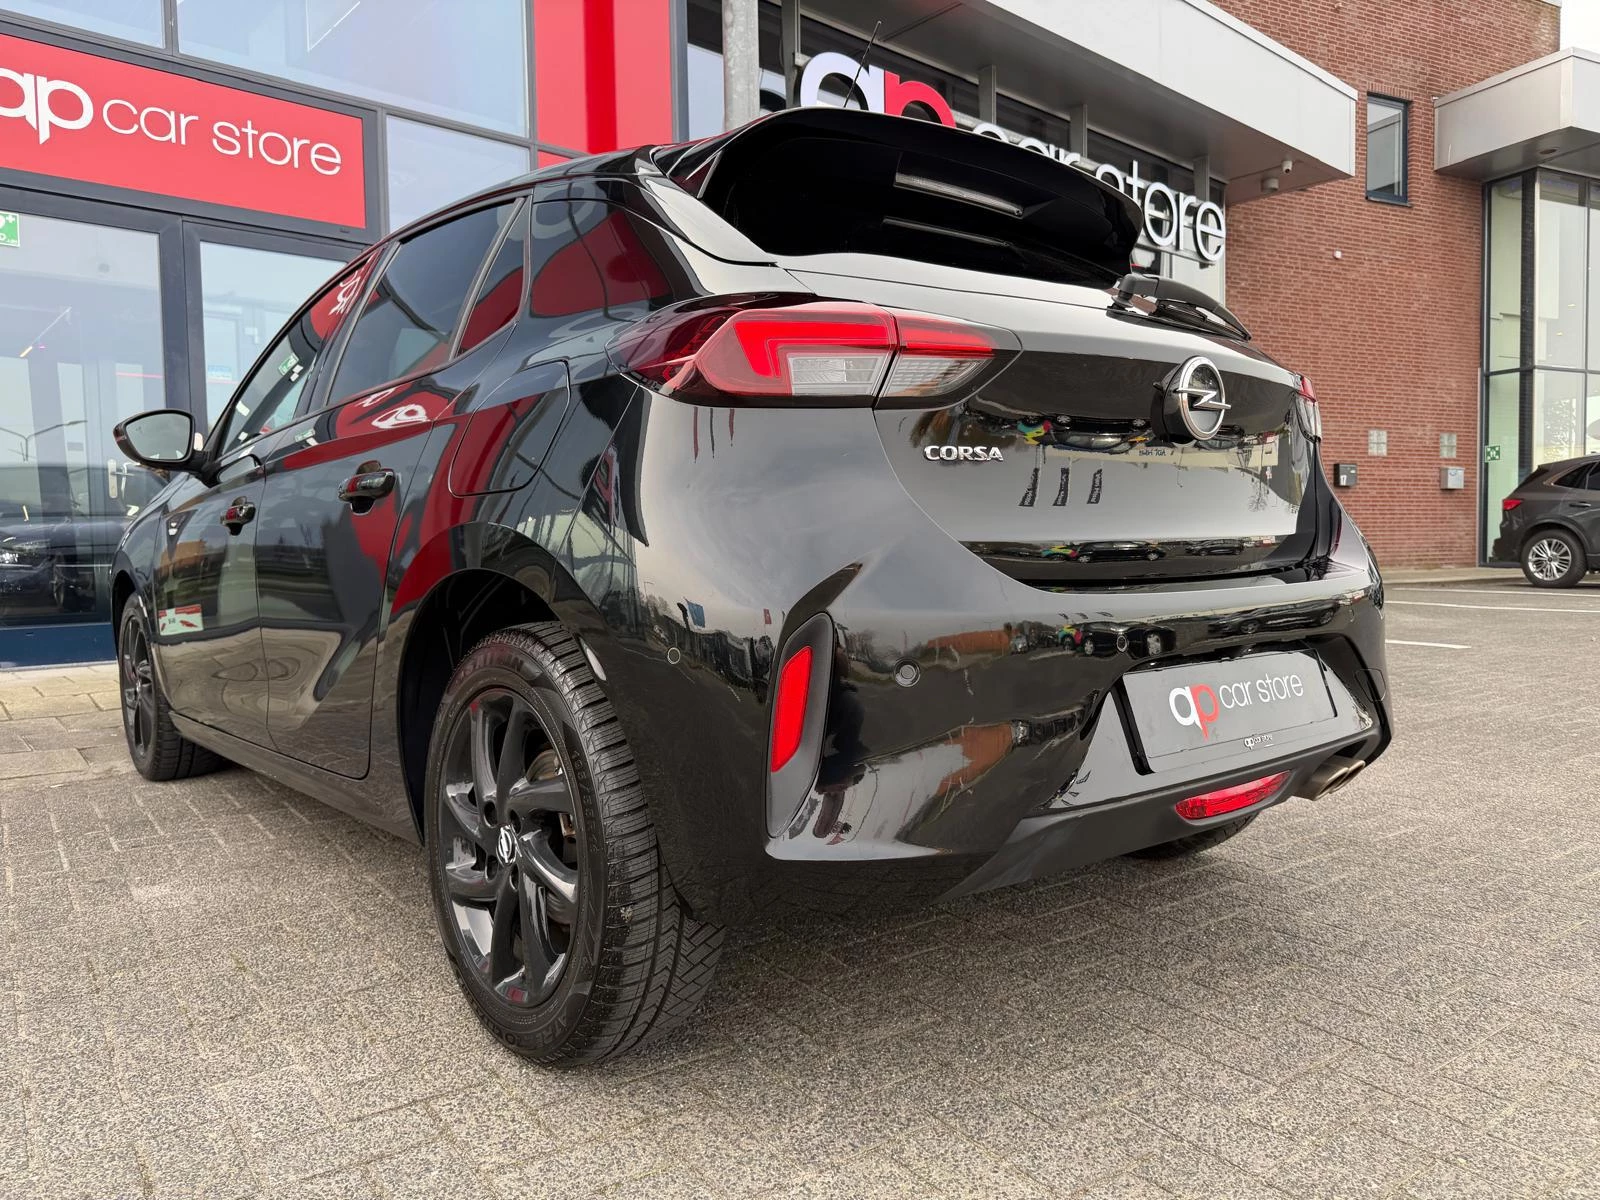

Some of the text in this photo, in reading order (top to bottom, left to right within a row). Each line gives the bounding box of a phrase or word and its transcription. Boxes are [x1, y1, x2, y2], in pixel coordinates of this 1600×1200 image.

[102, 99, 199, 145] car
[212, 120, 342, 176] store
[923, 445, 1004, 462] CORSA
[1168, 673, 1304, 743] ap car store
